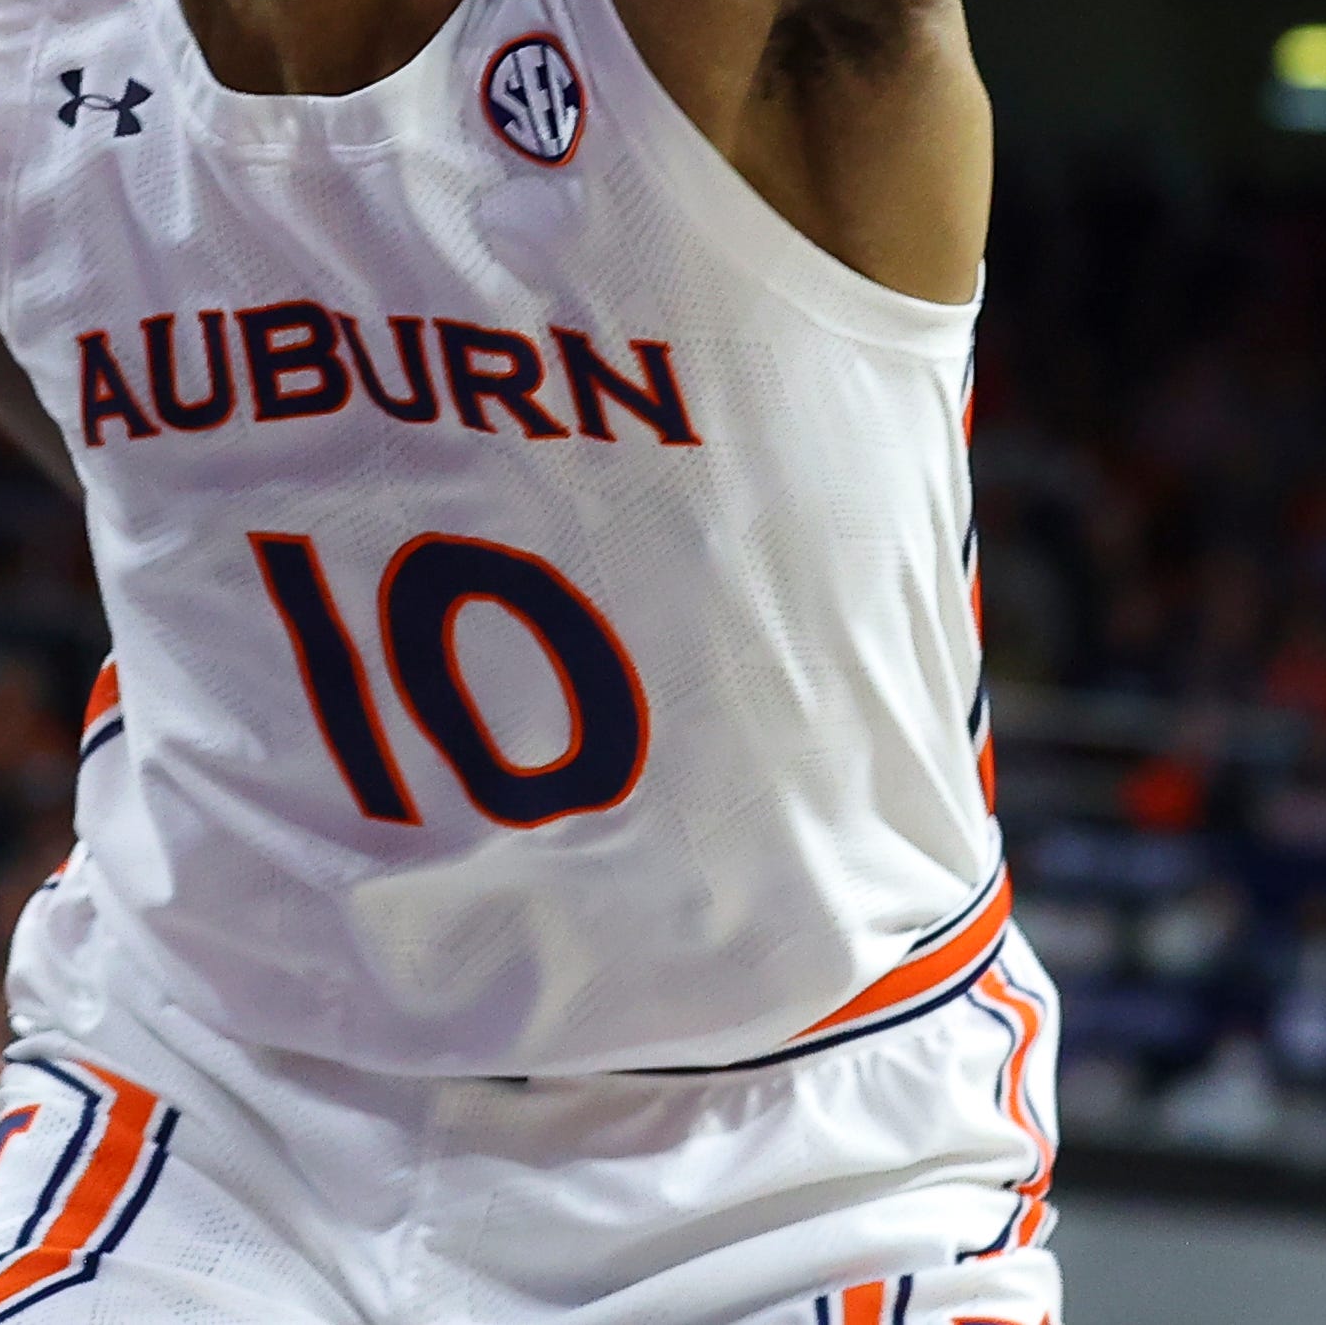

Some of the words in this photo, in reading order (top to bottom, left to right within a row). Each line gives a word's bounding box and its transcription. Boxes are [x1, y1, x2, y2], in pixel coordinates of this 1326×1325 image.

[489, 44, 579, 157] SEC
[77, 299, 704, 447] AUBURN
[247, 531, 651, 830] 10
